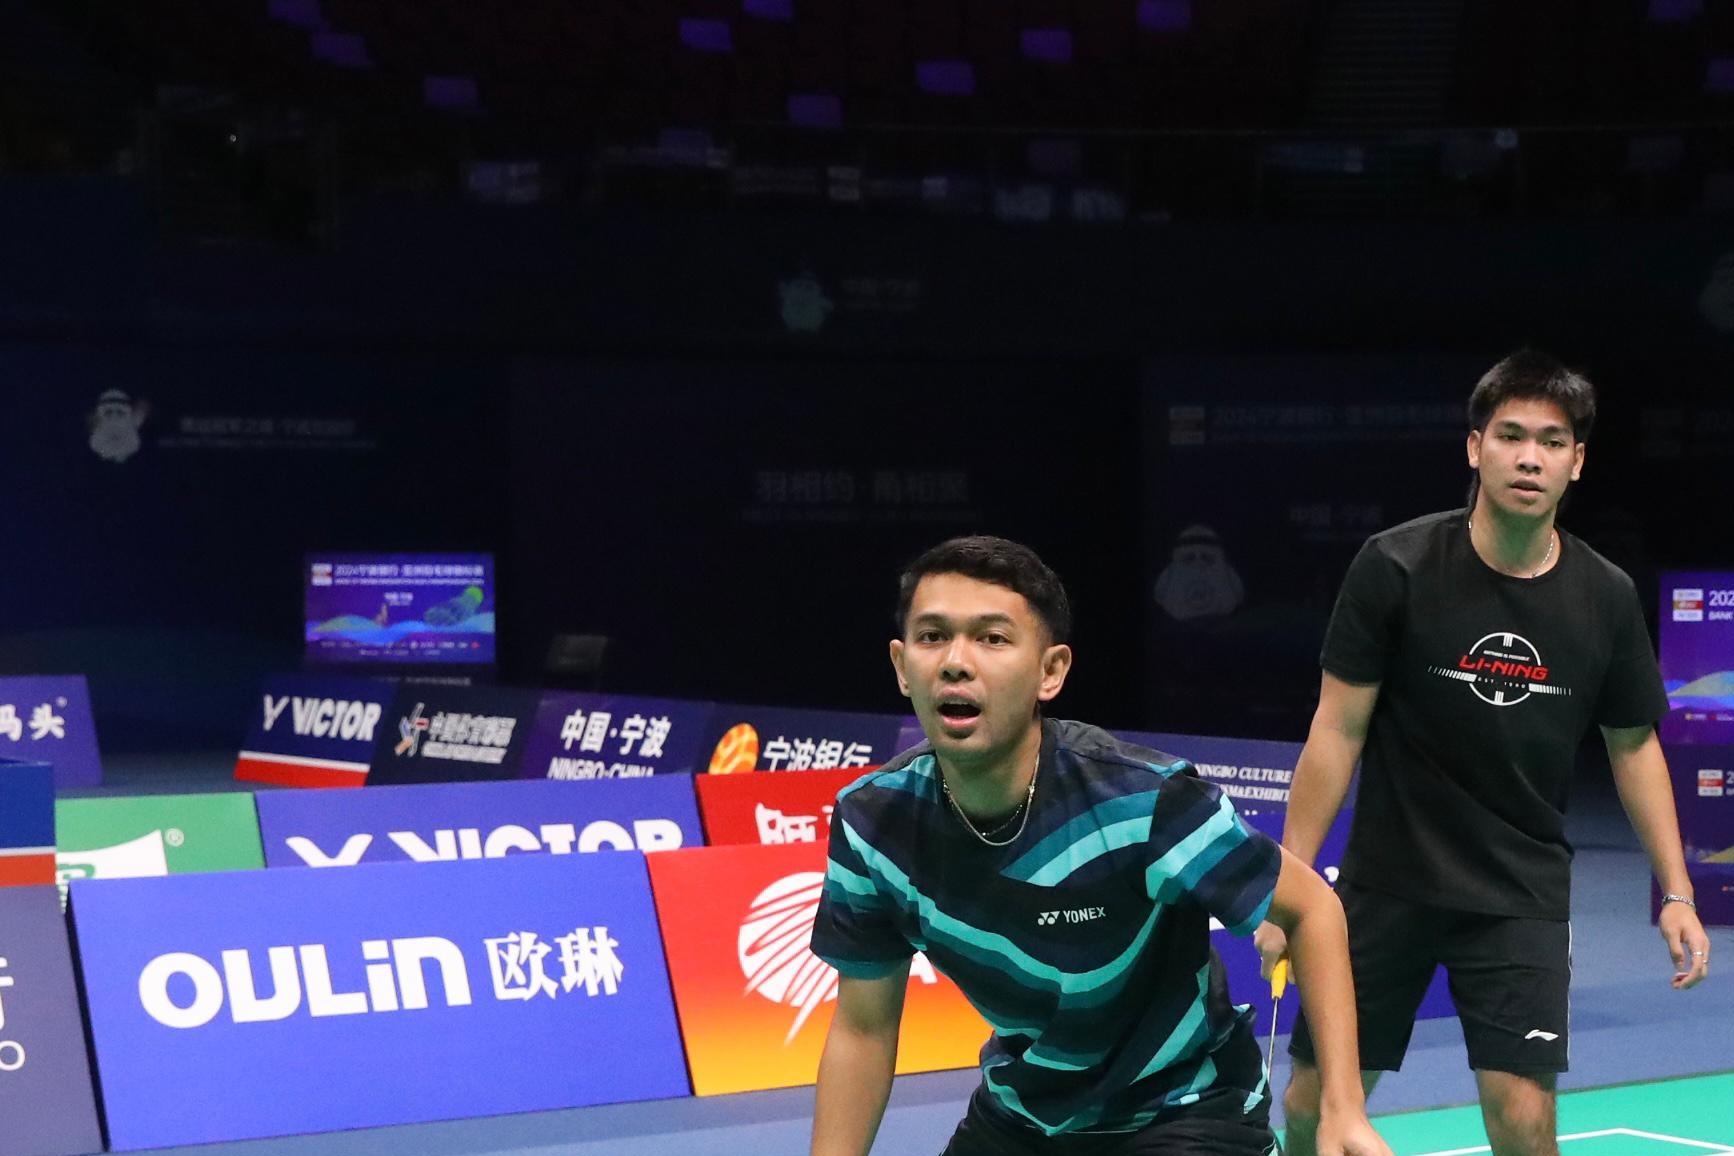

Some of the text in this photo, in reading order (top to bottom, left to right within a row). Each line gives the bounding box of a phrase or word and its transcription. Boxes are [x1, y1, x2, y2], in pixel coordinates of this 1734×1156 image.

[1459, 655, 1548, 681] LI-NING
[291, 697, 382, 741] VICTOR
[560, 708, 672, 759] 中国·宁波
[762, 736, 873, 772] 宁波银行
[1238, 767, 1293, 783] CULTURE
[1063, 906, 1106, 924] YONEX
[484, 926, 624, 1003] 欧琳
